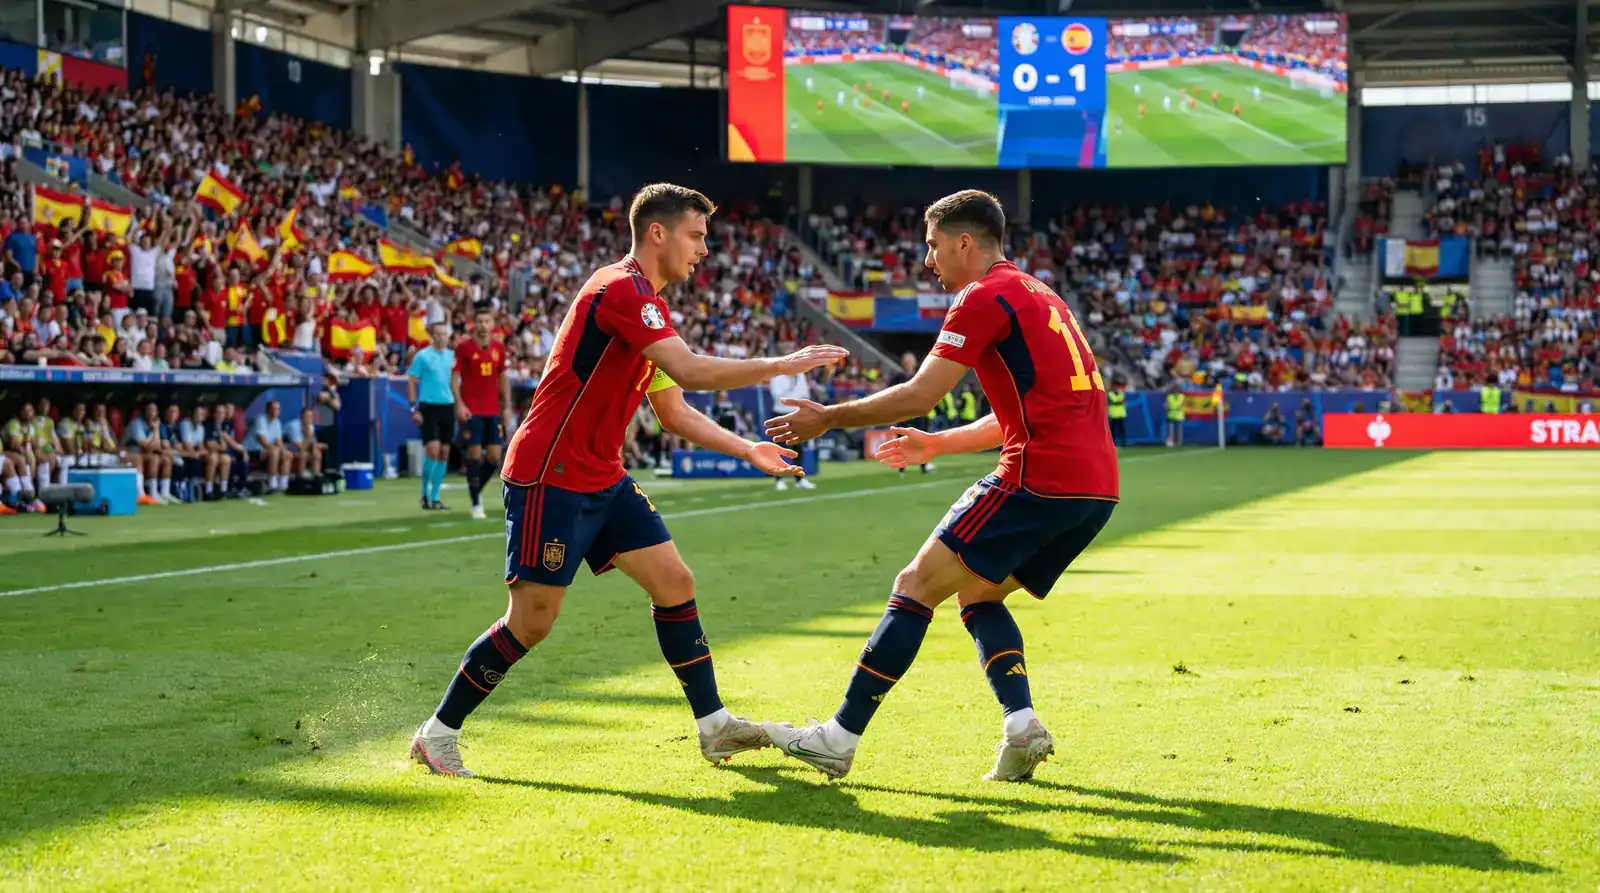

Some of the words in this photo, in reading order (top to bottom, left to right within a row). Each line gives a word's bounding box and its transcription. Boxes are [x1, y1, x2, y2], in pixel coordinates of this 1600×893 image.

[1013, 63, 1038, 92] 0
[1068, 63, 1086, 92] 1
[1531, 419, 1600, 444] STRA
